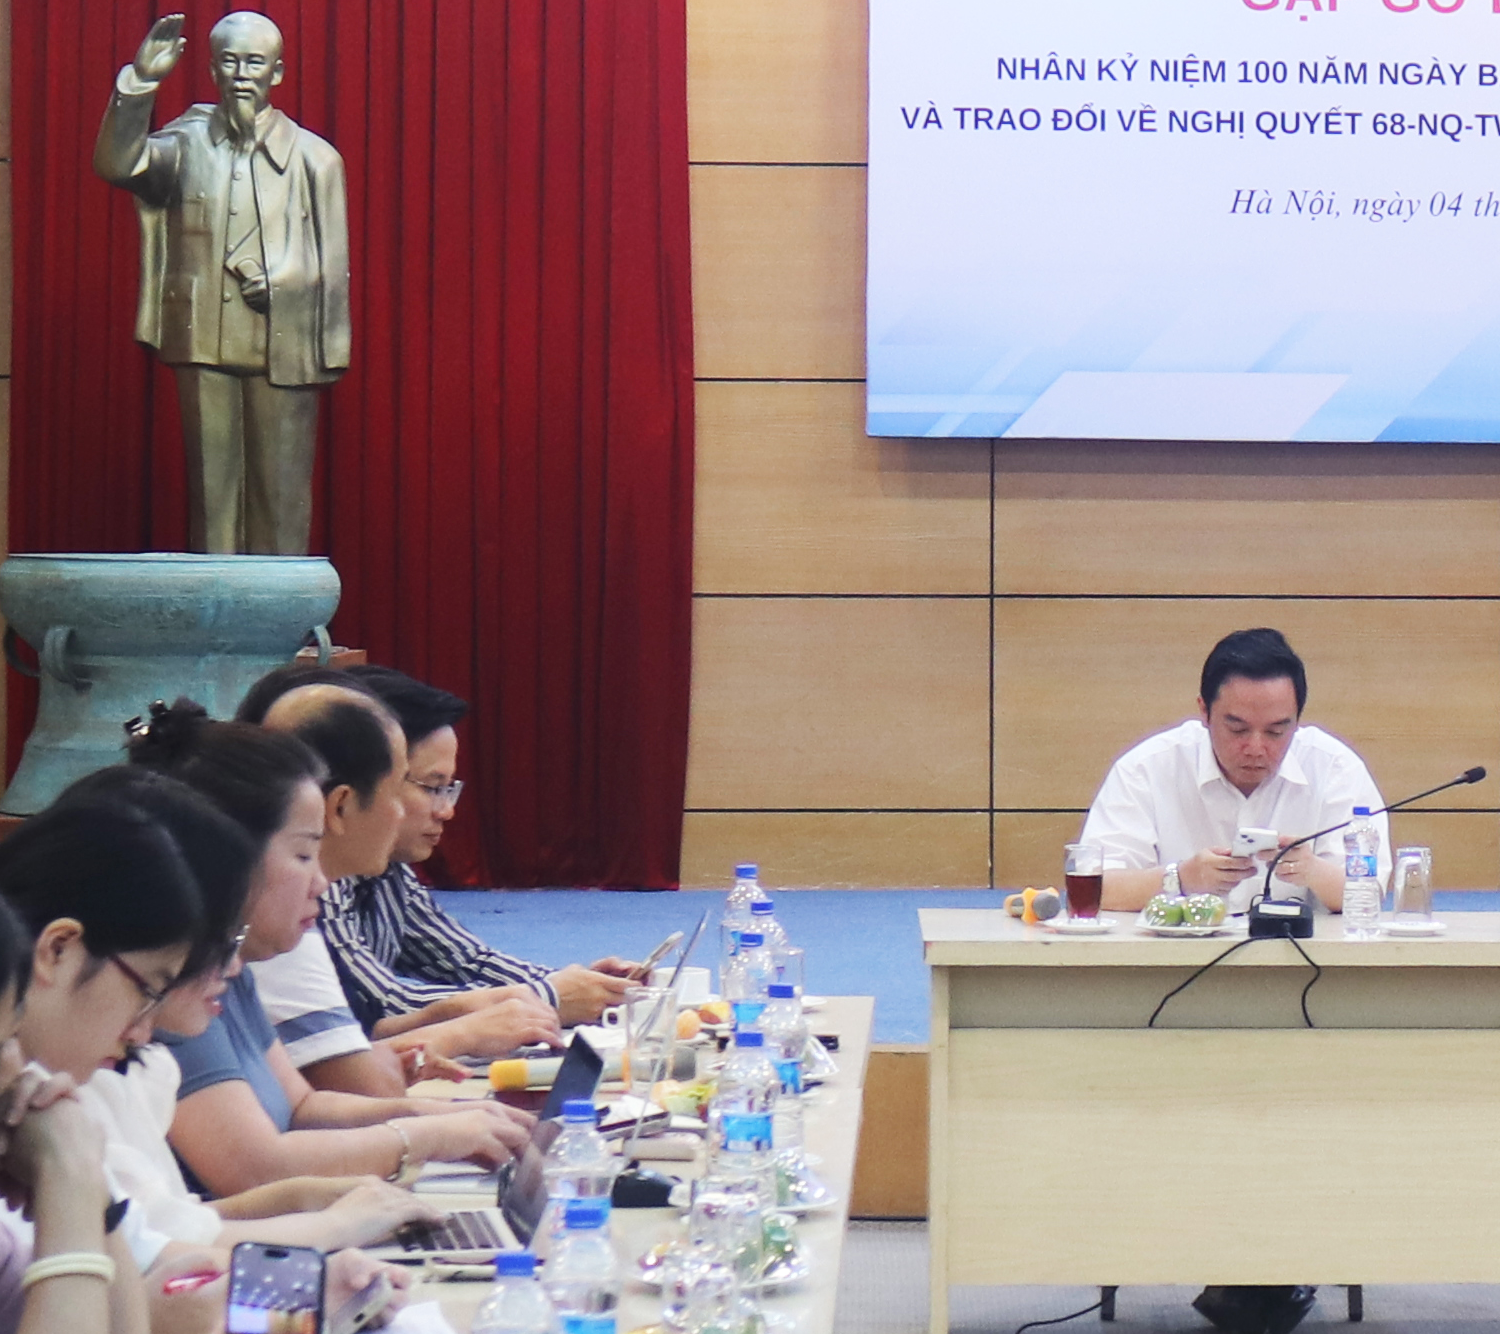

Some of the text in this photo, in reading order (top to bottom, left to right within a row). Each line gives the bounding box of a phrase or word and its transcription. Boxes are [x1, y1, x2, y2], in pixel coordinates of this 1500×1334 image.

[997, 51, 1086, 81] NHÂN
[1097, 52, 1139, 82] KỶ
[1150, 53, 1226, 89] NIỆM
[1237, 60, 1288, 84] 100
[1298, 55, 1368, 85] NĂM
[1379, 56, 1467, 86] NGÀY
[900, 100, 943, 130] VÀ
[952, 107, 1042, 131] TRAO
[1050, 102, 1106, 132] ĐỔI
[1116, 103, 1158, 133] VỀ
[1168, 109, 1245, 140] NGHỊ
[1255, 106, 1363, 141] QUYẾT
[1230, 189, 1273, 215] Hà
[1283, 189, 1340, 221] Nội,
[1352, 191, 1421, 223] ngày
[1429, 192, 1463, 217] 04
